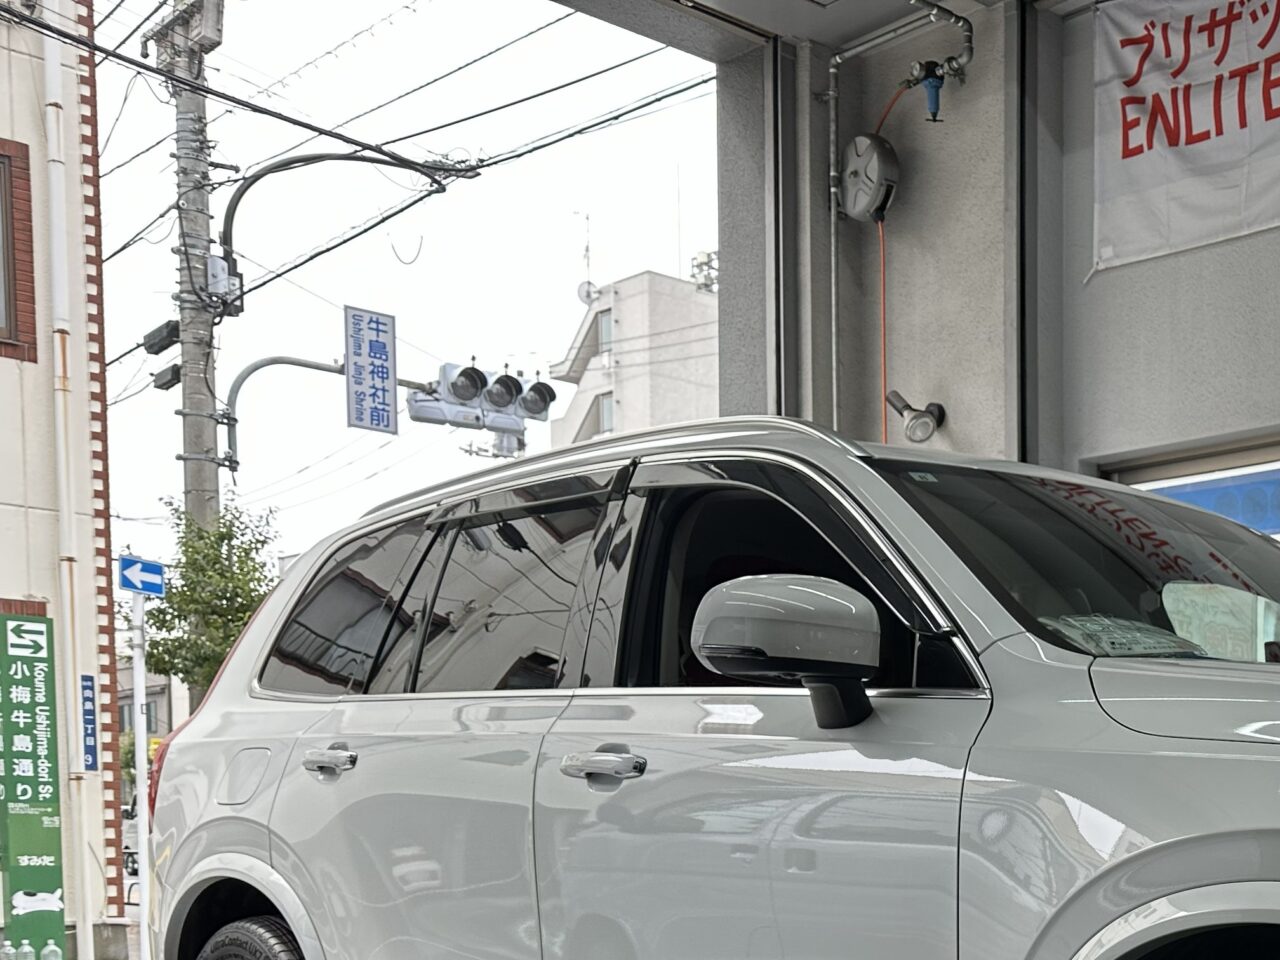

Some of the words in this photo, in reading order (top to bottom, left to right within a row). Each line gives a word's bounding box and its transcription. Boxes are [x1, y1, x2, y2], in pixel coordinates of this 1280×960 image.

[350, 313, 364, 357] Ushijima
[352, 361, 366, 386] Jinja
[367, 315, 391, 428] 牛島神社前
[354, 390, 367, 422] Shrine
[33, 662, 49, 703] Koume
[9, 660, 34, 800] 小梅牛島通り
[33, 706, 53, 782] Ushijima-dori
[38, 784, 54, 801] St.
[16, 855, 56, 867] すみだ
